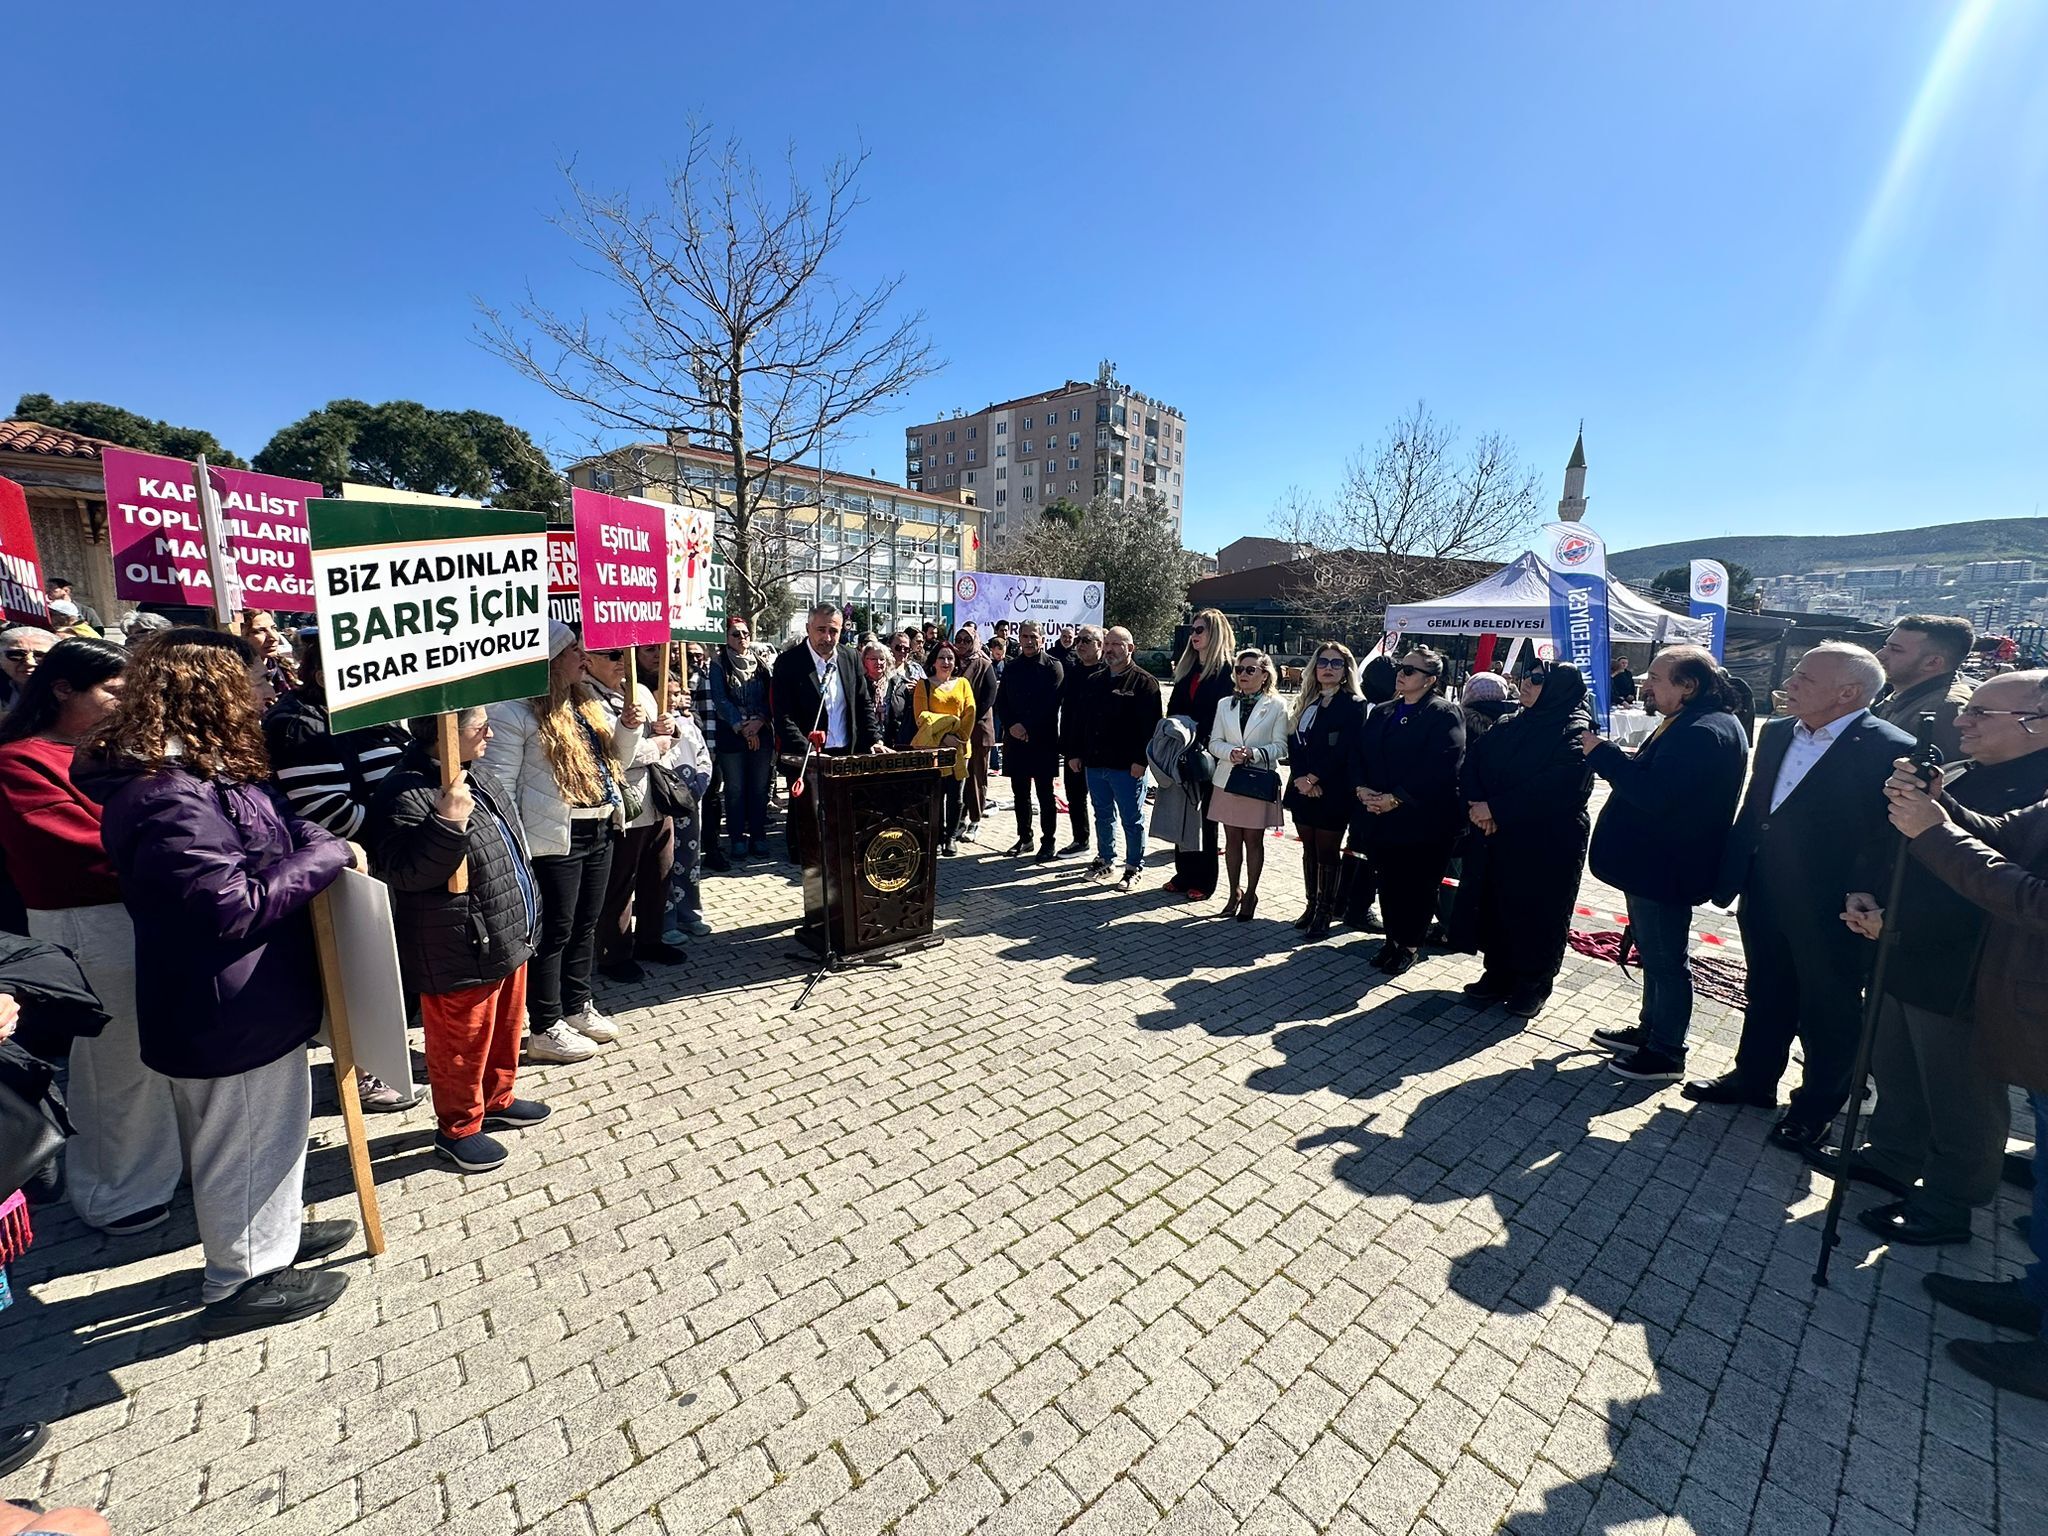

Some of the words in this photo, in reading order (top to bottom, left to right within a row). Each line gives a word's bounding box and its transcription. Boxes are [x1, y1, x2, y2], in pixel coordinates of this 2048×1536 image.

[138, 476, 300, 518] KAPALİST
[155, 537, 295, 569] MAURU
[600, 522, 651, 555] EŞİTLİK
[125, 563, 316, 596] OLMAACAĞIZ
[390, 548, 538, 587] KADINLAR
[596, 562, 618, 586] VE
[620, 565, 658, 593] BARIŞ
[331, 595, 459, 650] BARIŞ
[470, 580, 539, 627] İÇİN
[593, 596, 663, 624] İSTİYORUZ
[1427, 617, 1470, 628] GEMLİK
[1473, 618, 1545, 629] BELEDİYESİ
[337, 652, 418, 691] ISRAR
